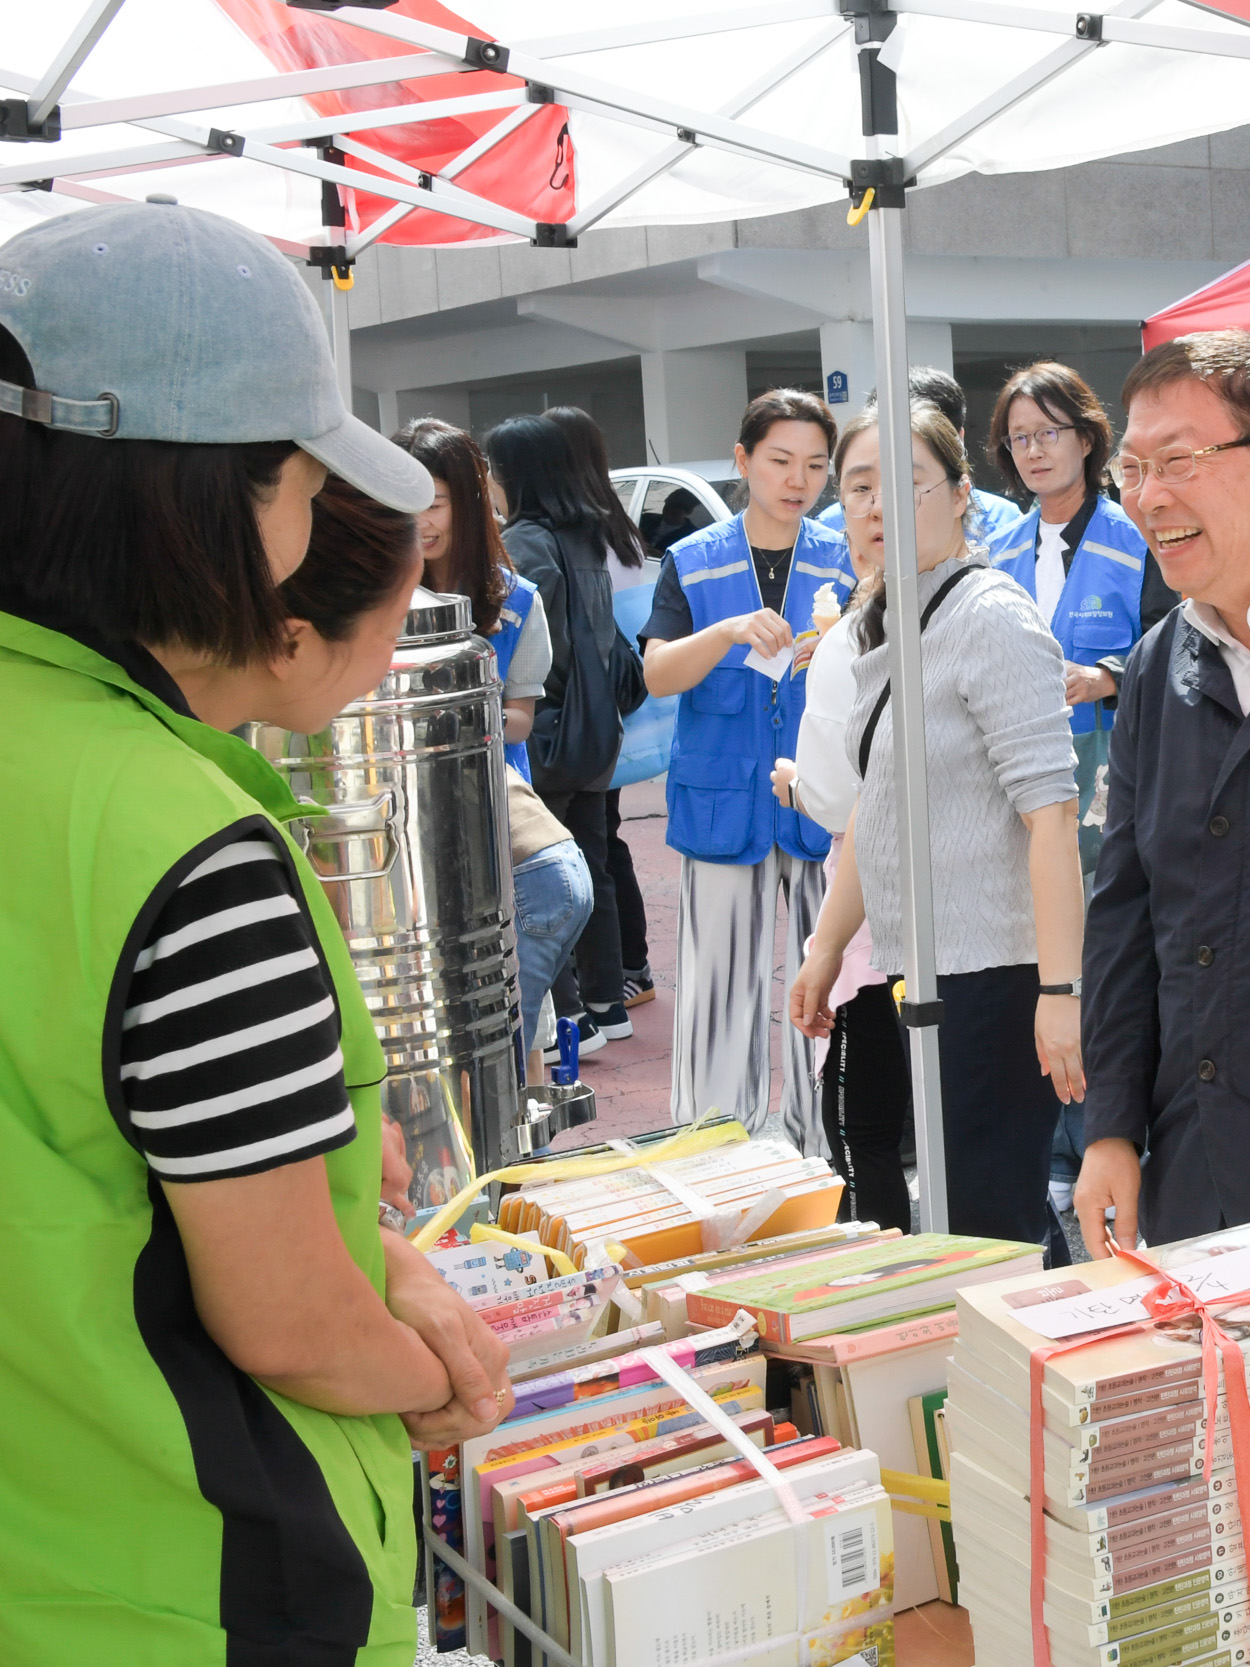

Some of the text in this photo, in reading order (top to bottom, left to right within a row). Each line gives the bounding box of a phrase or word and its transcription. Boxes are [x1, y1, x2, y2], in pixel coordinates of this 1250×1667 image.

[832, 375, 843, 390] 59
[513, 1294, 551, 1315] 거짓말
[1217, 1546, 1225, 1556] 11
[1215, 1570, 1224, 1580] 10
